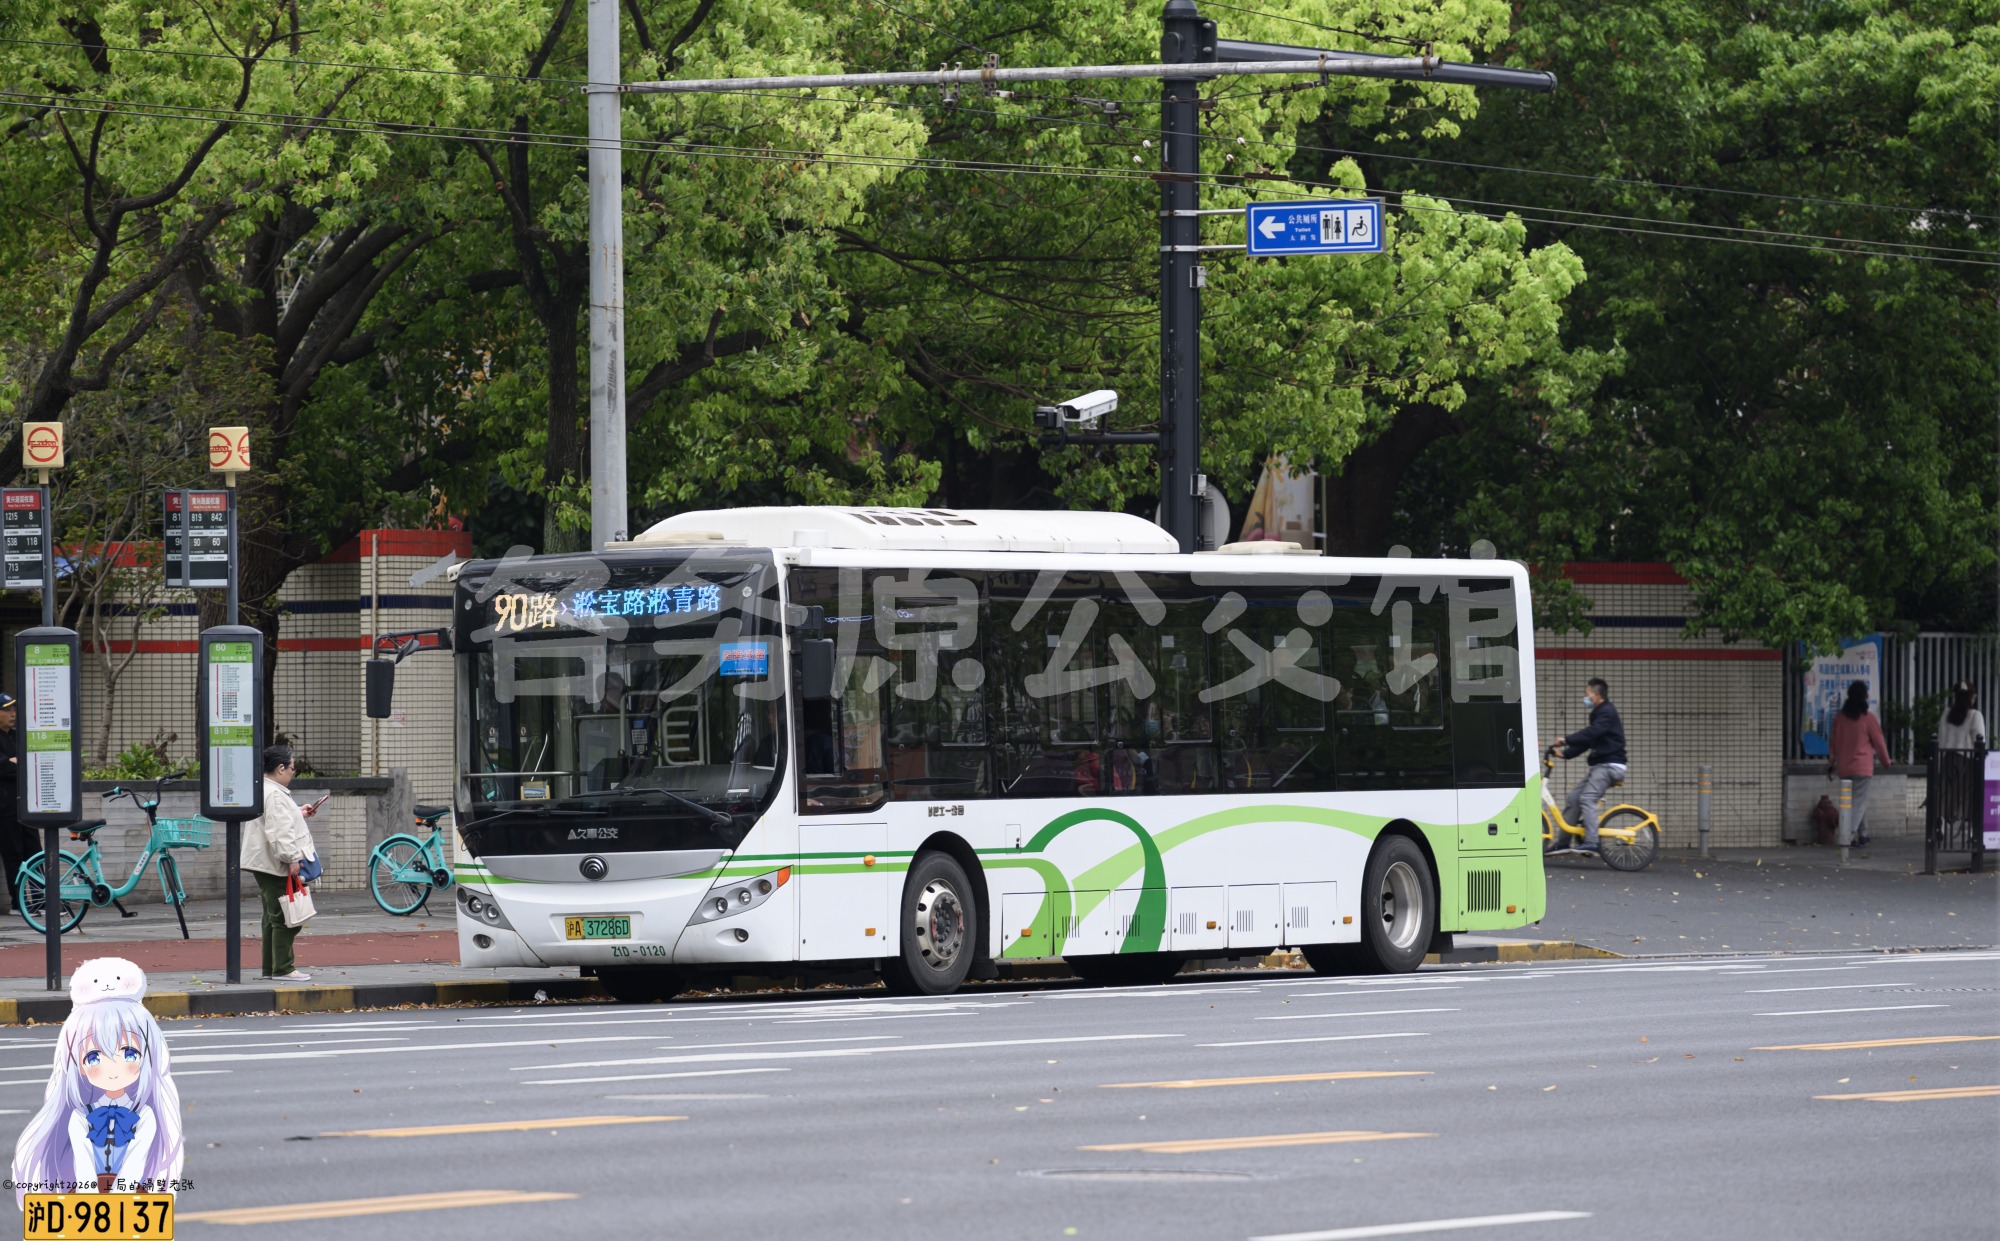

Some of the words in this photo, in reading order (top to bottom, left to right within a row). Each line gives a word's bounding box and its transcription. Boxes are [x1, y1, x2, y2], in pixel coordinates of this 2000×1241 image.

[5, 512, 18, 521] 1215
[28, 511, 33, 520] 8
[191, 513, 202, 521] 819
[211, 513, 223, 521] 842
[7, 537, 18, 546] 538
[27, 537, 38, 546] 118
[212, 537, 221, 546] 60
[8, 563, 19, 572] 713
[572, 584, 722, 618] 淞宝路淞青路
[34, 646, 40, 654] 8
[215, 643, 226, 651] 60
